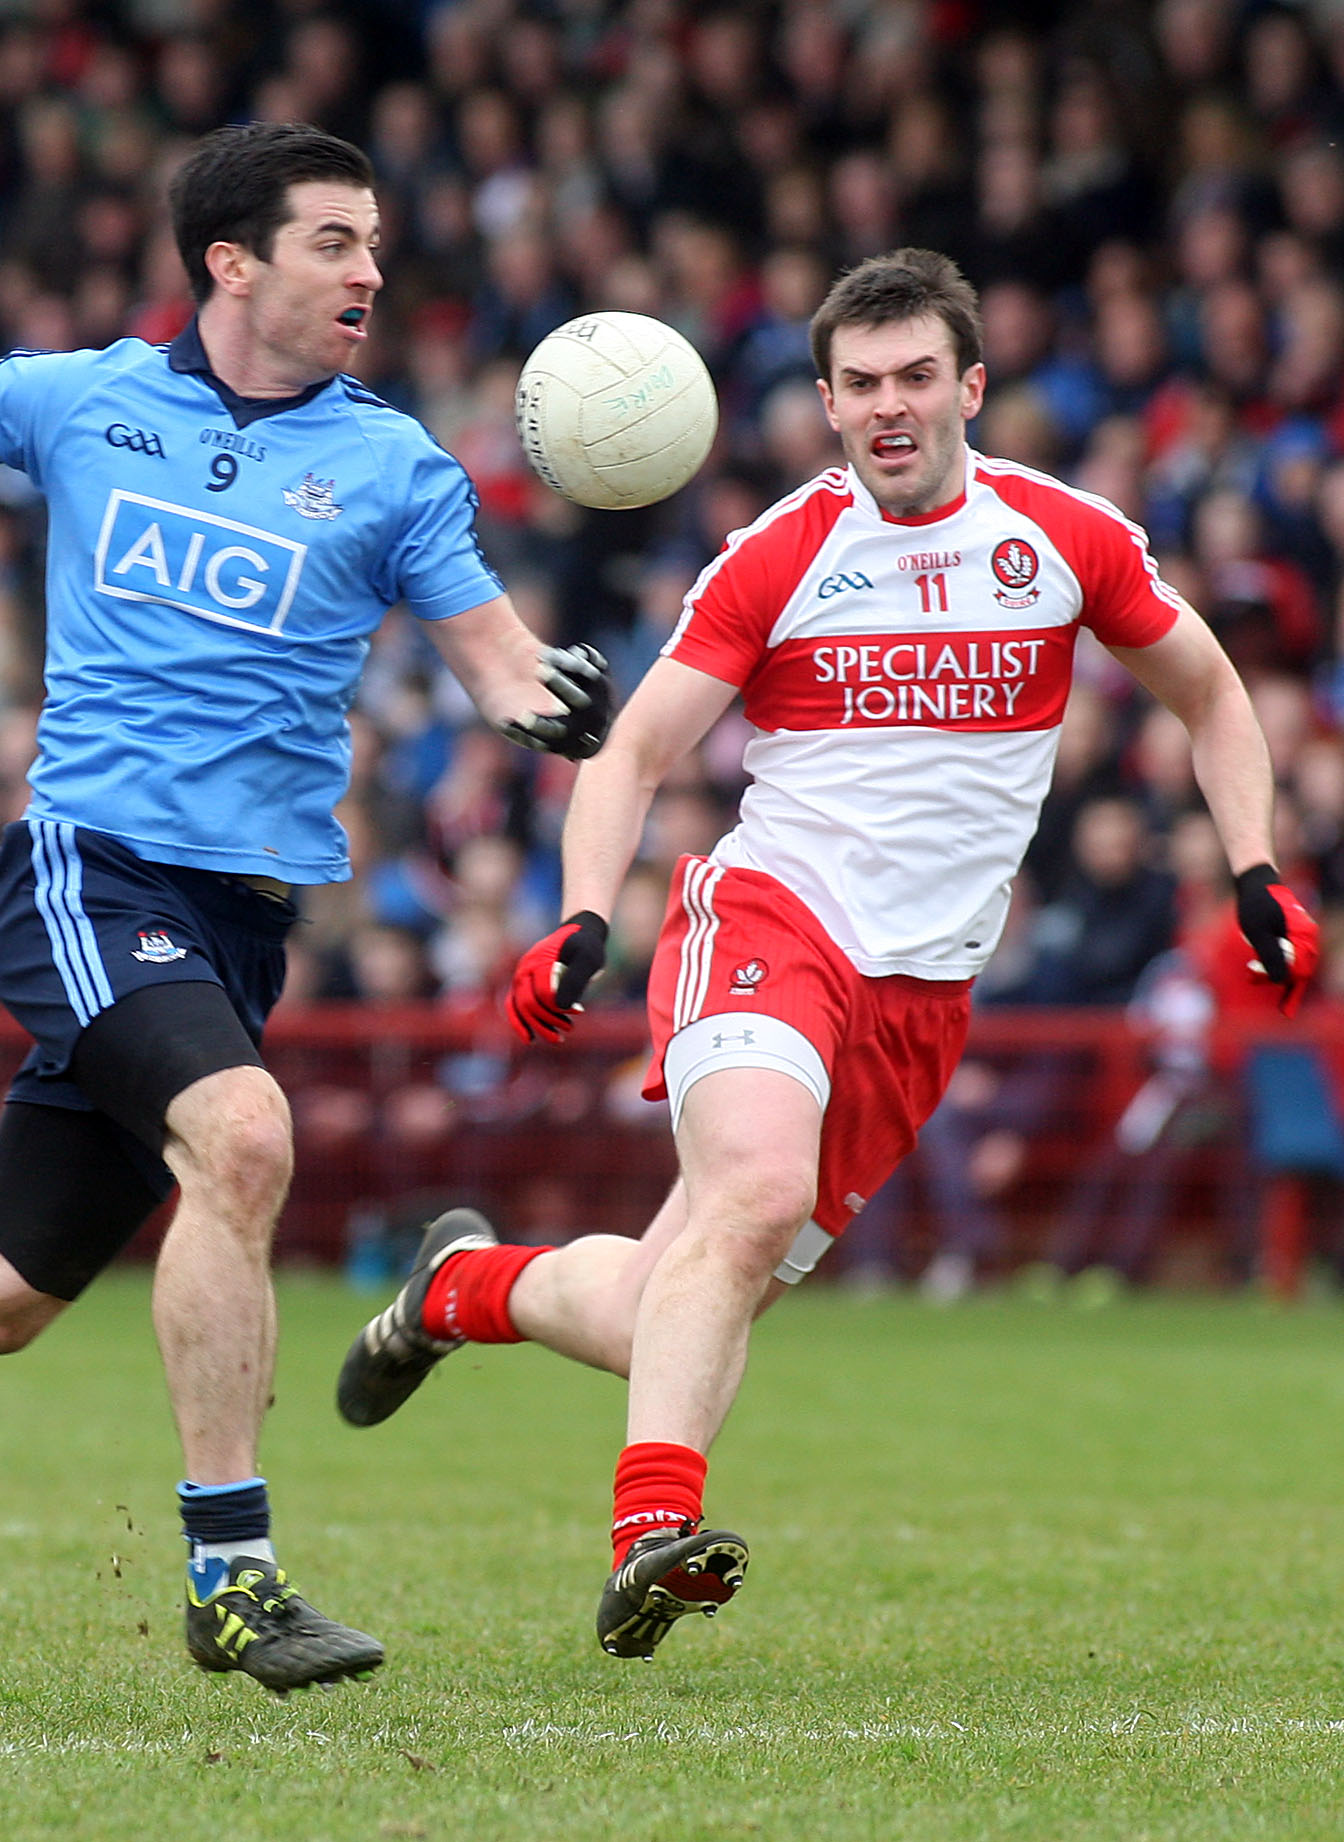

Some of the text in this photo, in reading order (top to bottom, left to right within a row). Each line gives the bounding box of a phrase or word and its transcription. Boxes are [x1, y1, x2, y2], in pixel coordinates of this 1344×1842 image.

[198, 428, 267, 462] O'NEILLS
[204, 453, 238, 492] 9
[112, 522, 271, 609] AIG
[897, 551, 961, 571] O'NEILLS
[914, 573, 949, 613] 11
[811, 639, 1045, 683] SPECIALIST
[839, 682, 1025, 725] JOINERY
